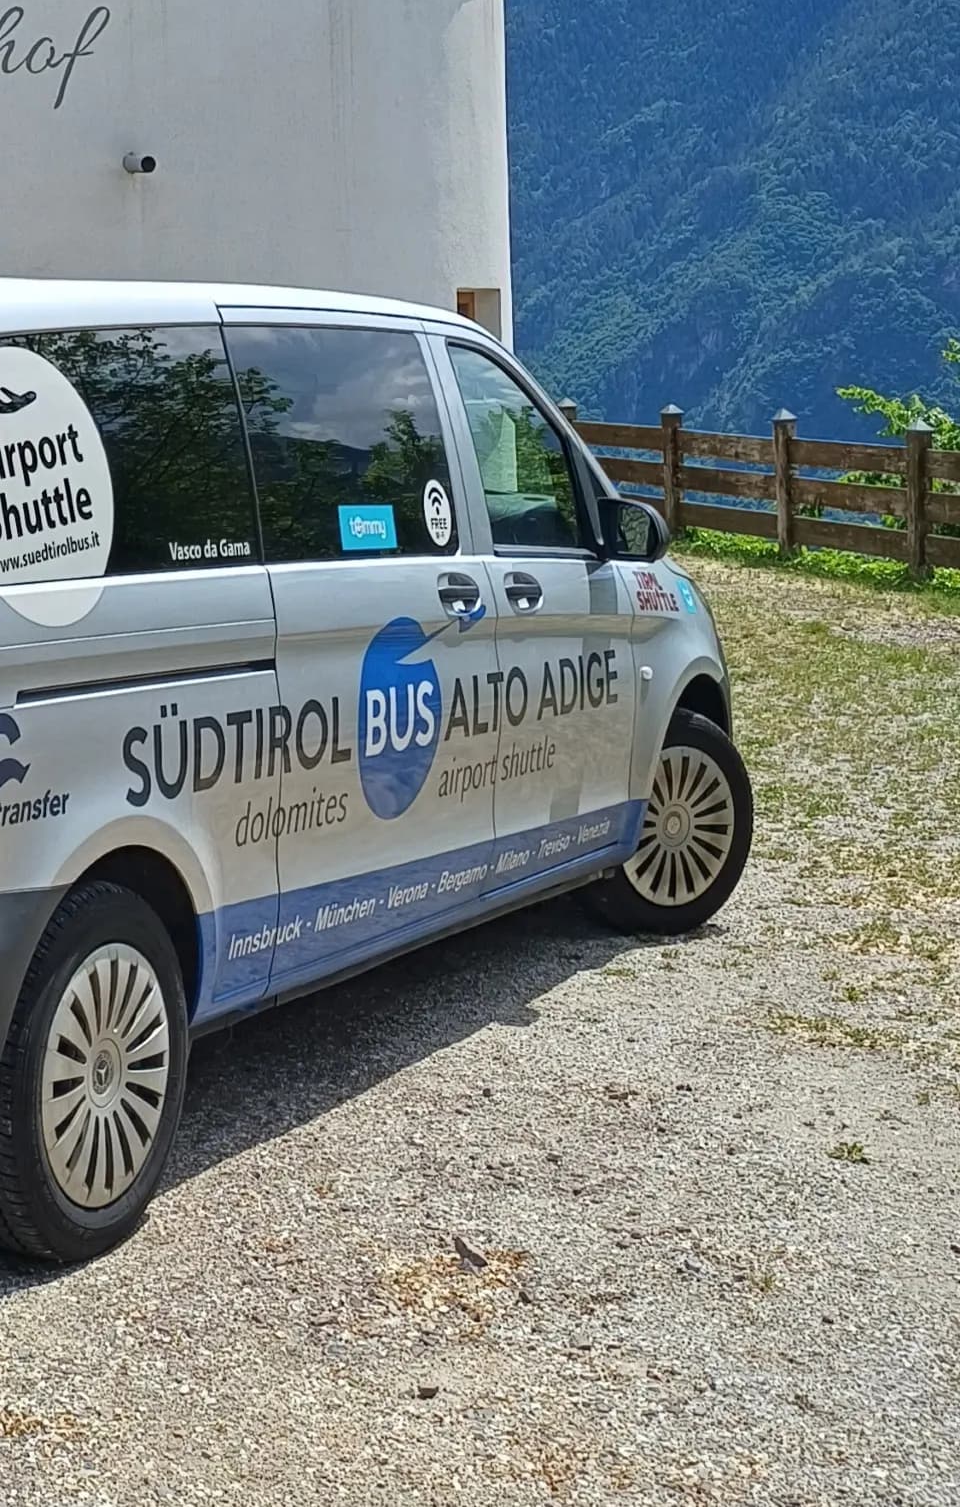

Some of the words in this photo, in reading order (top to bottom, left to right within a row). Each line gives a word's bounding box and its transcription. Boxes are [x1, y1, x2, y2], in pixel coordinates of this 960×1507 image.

[349, 516, 387, 539] tommy
[431, 518, 447, 530] FREE
[169, 541, 202, 561] Vasco
[204, 539, 218, 559] da
[219, 539, 250, 557] Gama
[636, 589, 679, 612] SHUTTLE
[122, 696, 352, 807] SÜDTIROL
[365, 680, 435, 757] BUS
[444, 666, 528, 741] ALTO
[537, 649, 618, 721] ADIGE
[235, 786, 348, 847] dolomites
[438, 756, 497, 802] airport
[501, 735, 555, 782] shuttle
[228, 914, 303, 960] Innsbruck
[314, 897, 375, 933] München
[387, 881, 429, 909] Verona
[437, 863, 488, 894] Bergamo
[495, 849, 530, 874] Milano
[537, 833, 570, 860] Treviso
[577, 816, 611, 845] Venezia
